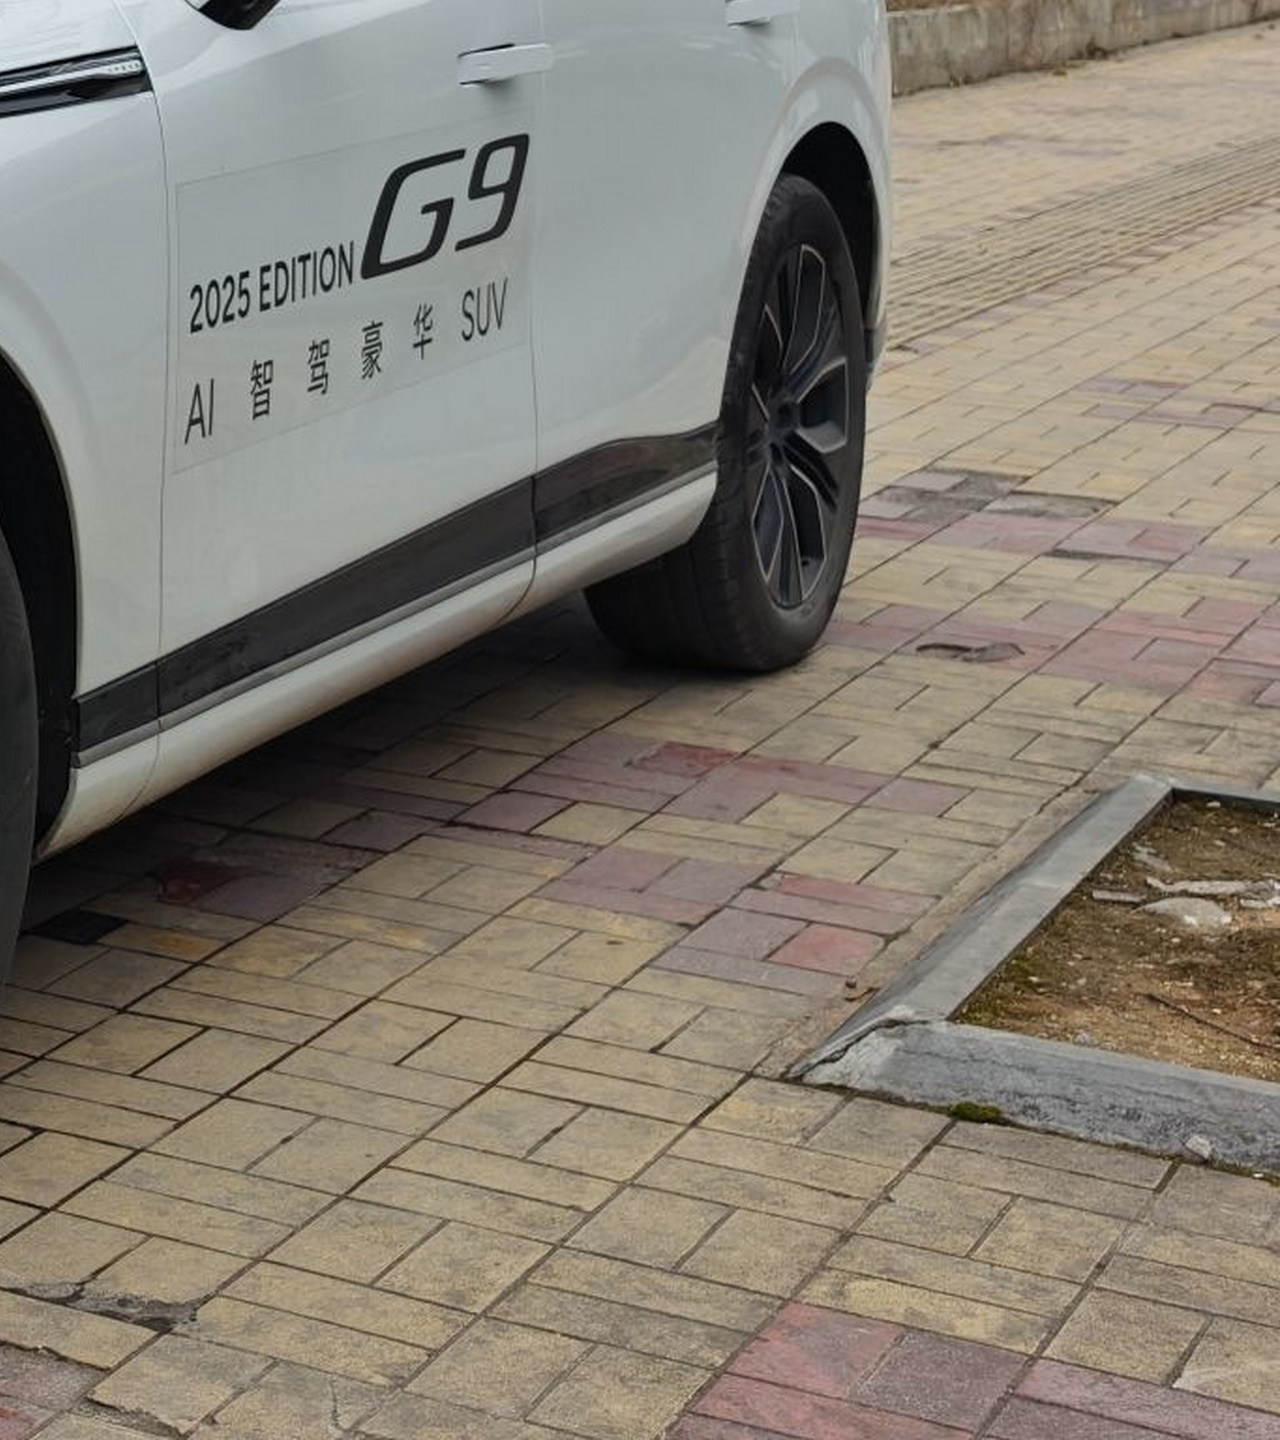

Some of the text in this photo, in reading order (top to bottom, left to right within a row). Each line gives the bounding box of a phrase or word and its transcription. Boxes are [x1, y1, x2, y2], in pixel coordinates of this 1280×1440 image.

[190, 133, 530, 334] 2025 EDITION G9
[184, 277, 508, 445] AI 智驾豪华 SUV
